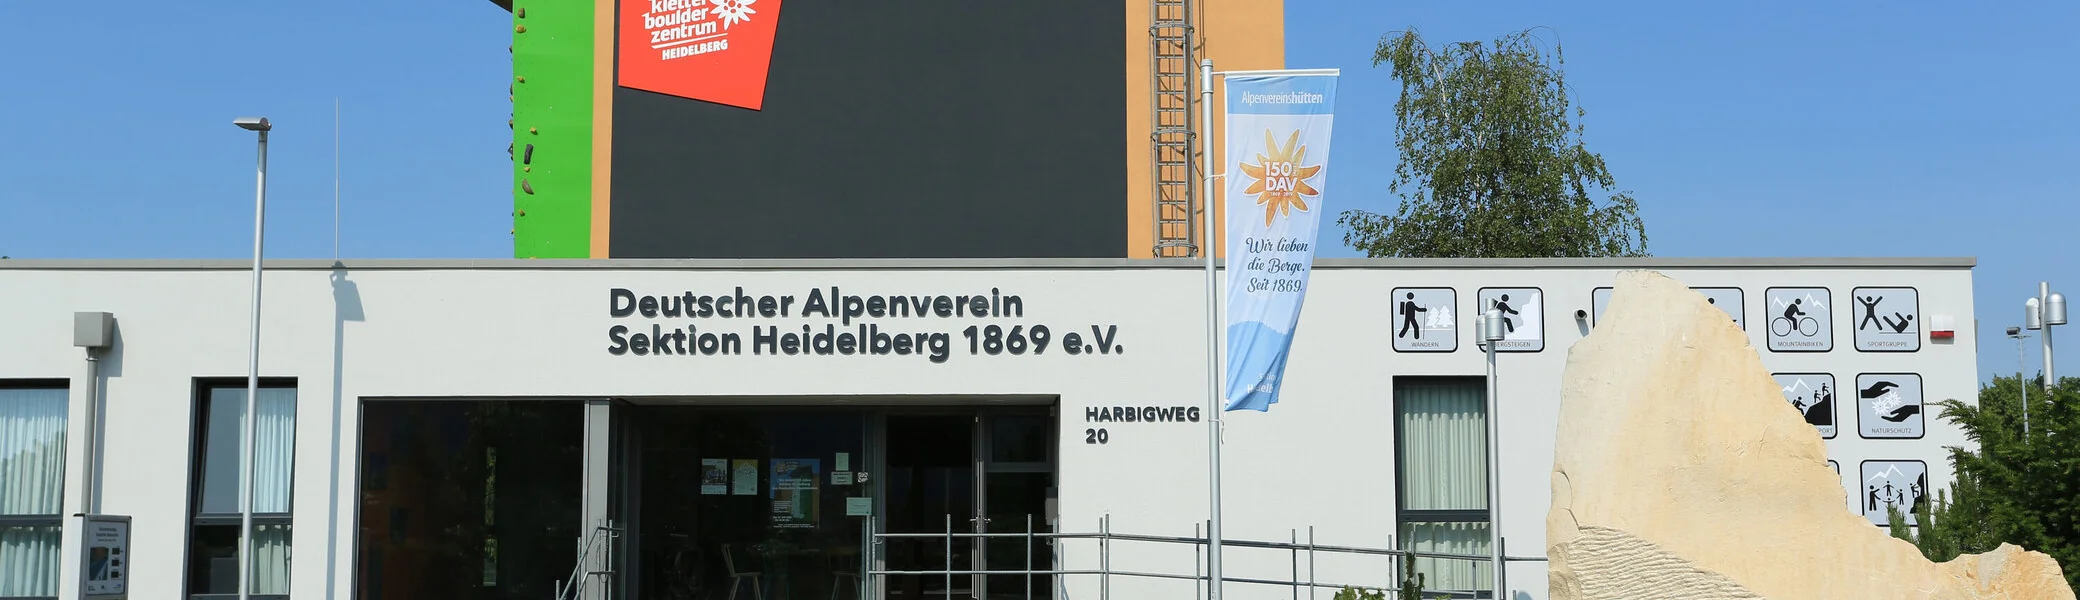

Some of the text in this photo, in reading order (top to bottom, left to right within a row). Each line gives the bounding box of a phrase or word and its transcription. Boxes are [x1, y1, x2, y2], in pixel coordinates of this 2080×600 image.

[641, 7, 709, 30] boulder
[650, 20, 717, 43] zentrum
[662, 39, 728, 60] HEIDELBERG
[1241, 91, 1323, 107] Alpenvereinshütten
[1264, 161, 1293, 177] 150
[1265, 176, 1298, 192] DAV
[1245, 236, 1309, 254] Wir lieben
[1247, 256, 1305, 276] die Berge.
[1247, 277, 1269, 293] Seit
[610, 286, 1024, 327] Deutscher Alpenverein
[608, 323, 1124, 364] Sektion Heidelberg 1869 e.V.
[1085, 406, 1201, 424] HARBIGWEG
[1085, 428, 1109, 445] 20
